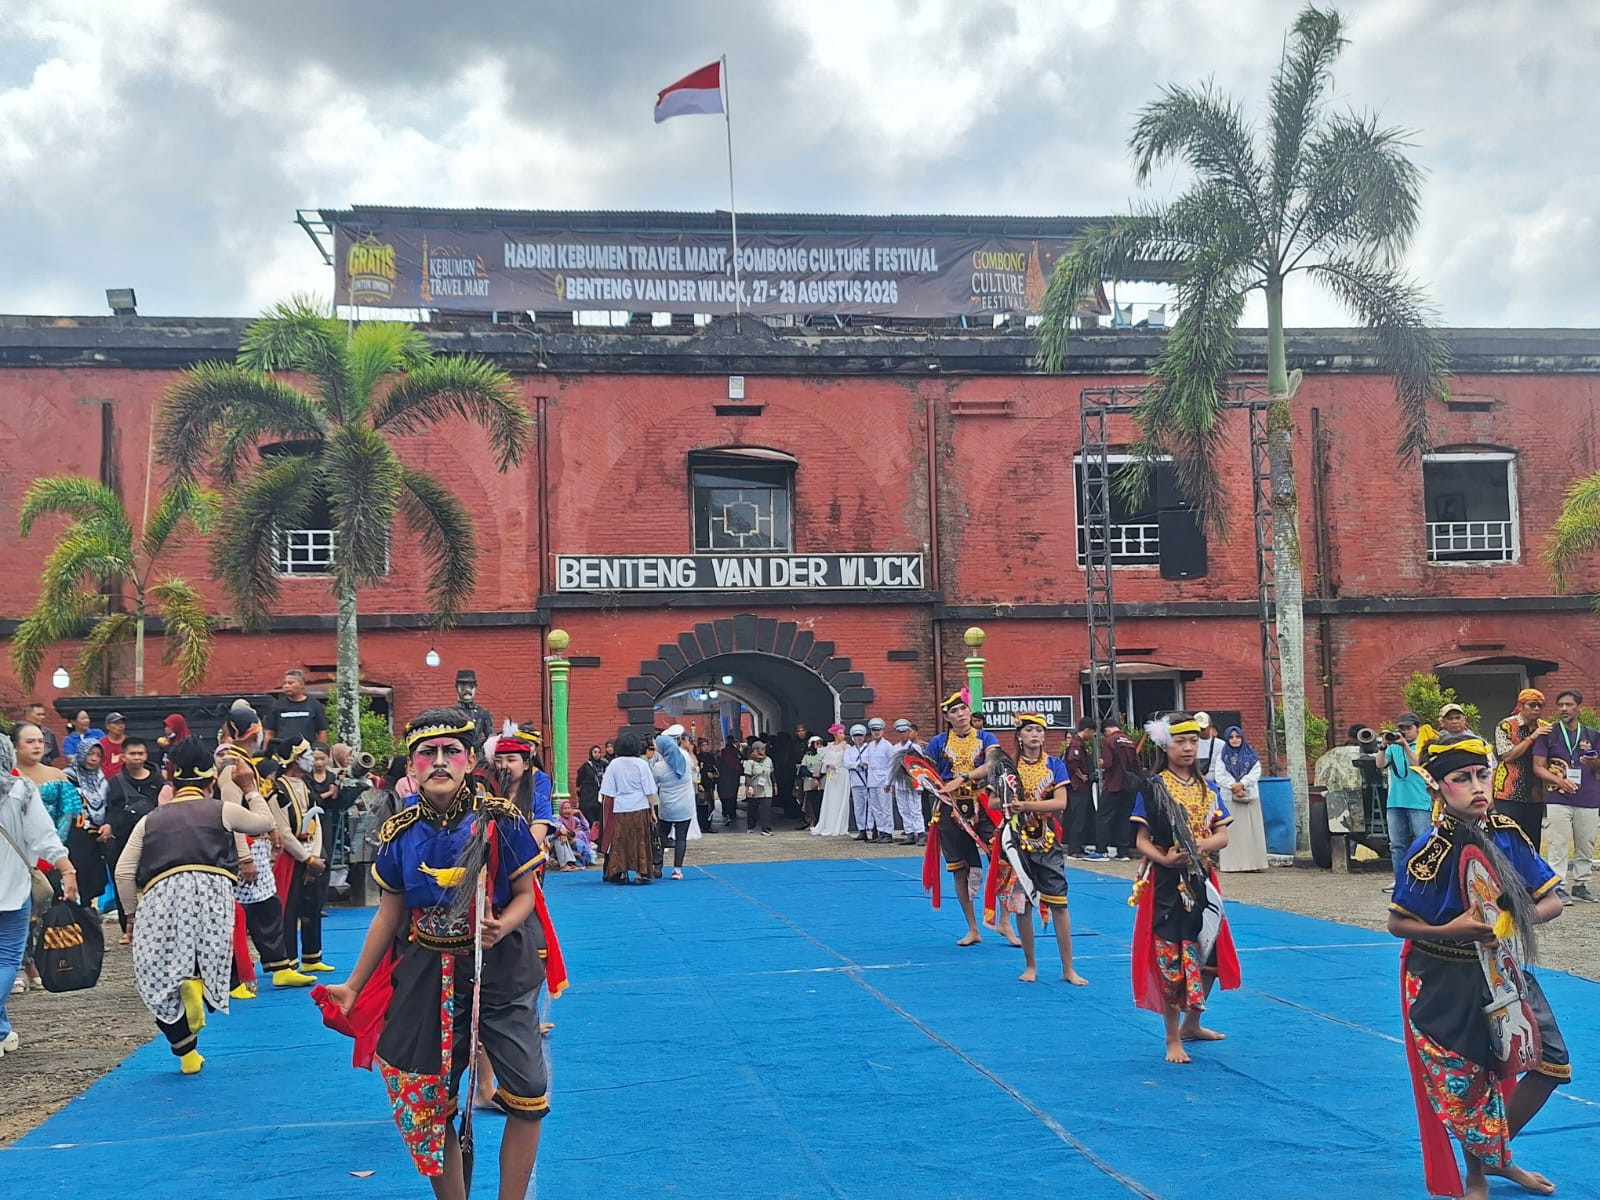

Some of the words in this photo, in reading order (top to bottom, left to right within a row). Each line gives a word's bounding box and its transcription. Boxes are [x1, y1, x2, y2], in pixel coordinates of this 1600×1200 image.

[430, 258, 475, 278] KEBUMEN
[504, 243, 555, 268] HADIRI
[557, 244, 628, 270] KEBUMEN
[629, 245, 683, 271] TRAVEL
[685, 247, 731, 277] MART,
[734, 247, 807, 272] GOMBONG
[809, 247, 870, 272] CULTURE
[875, 247, 938, 272] FESTIVAL
[973, 251, 1025, 271] GOMBONG
[430, 279, 463, 296] TRAVEL
[465, 279, 490, 297] MART
[566, 277, 632, 300] BENTENG
[634, 278, 667, 301] VAN
[669, 279, 696, 302] DER
[698, 280, 751, 307] WIJCK,
[753, 280, 768, 303] 27
[780, 280, 796, 303] 29
[798, 280, 862, 304] AGUSTUS
[863, 280, 898, 304] 2026
[972, 273, 1024, 294] CULTURE
[982, 295, 1025, 310] FESTIVAL
[560, 558, 696, 588] BENTENG
[712, 558, 761, 587] VAN
[770, 558, 827, 587] DER
[839, 557, 920, 587] WIJCK
[998, 700, 1062, 713] DIBANGUN
